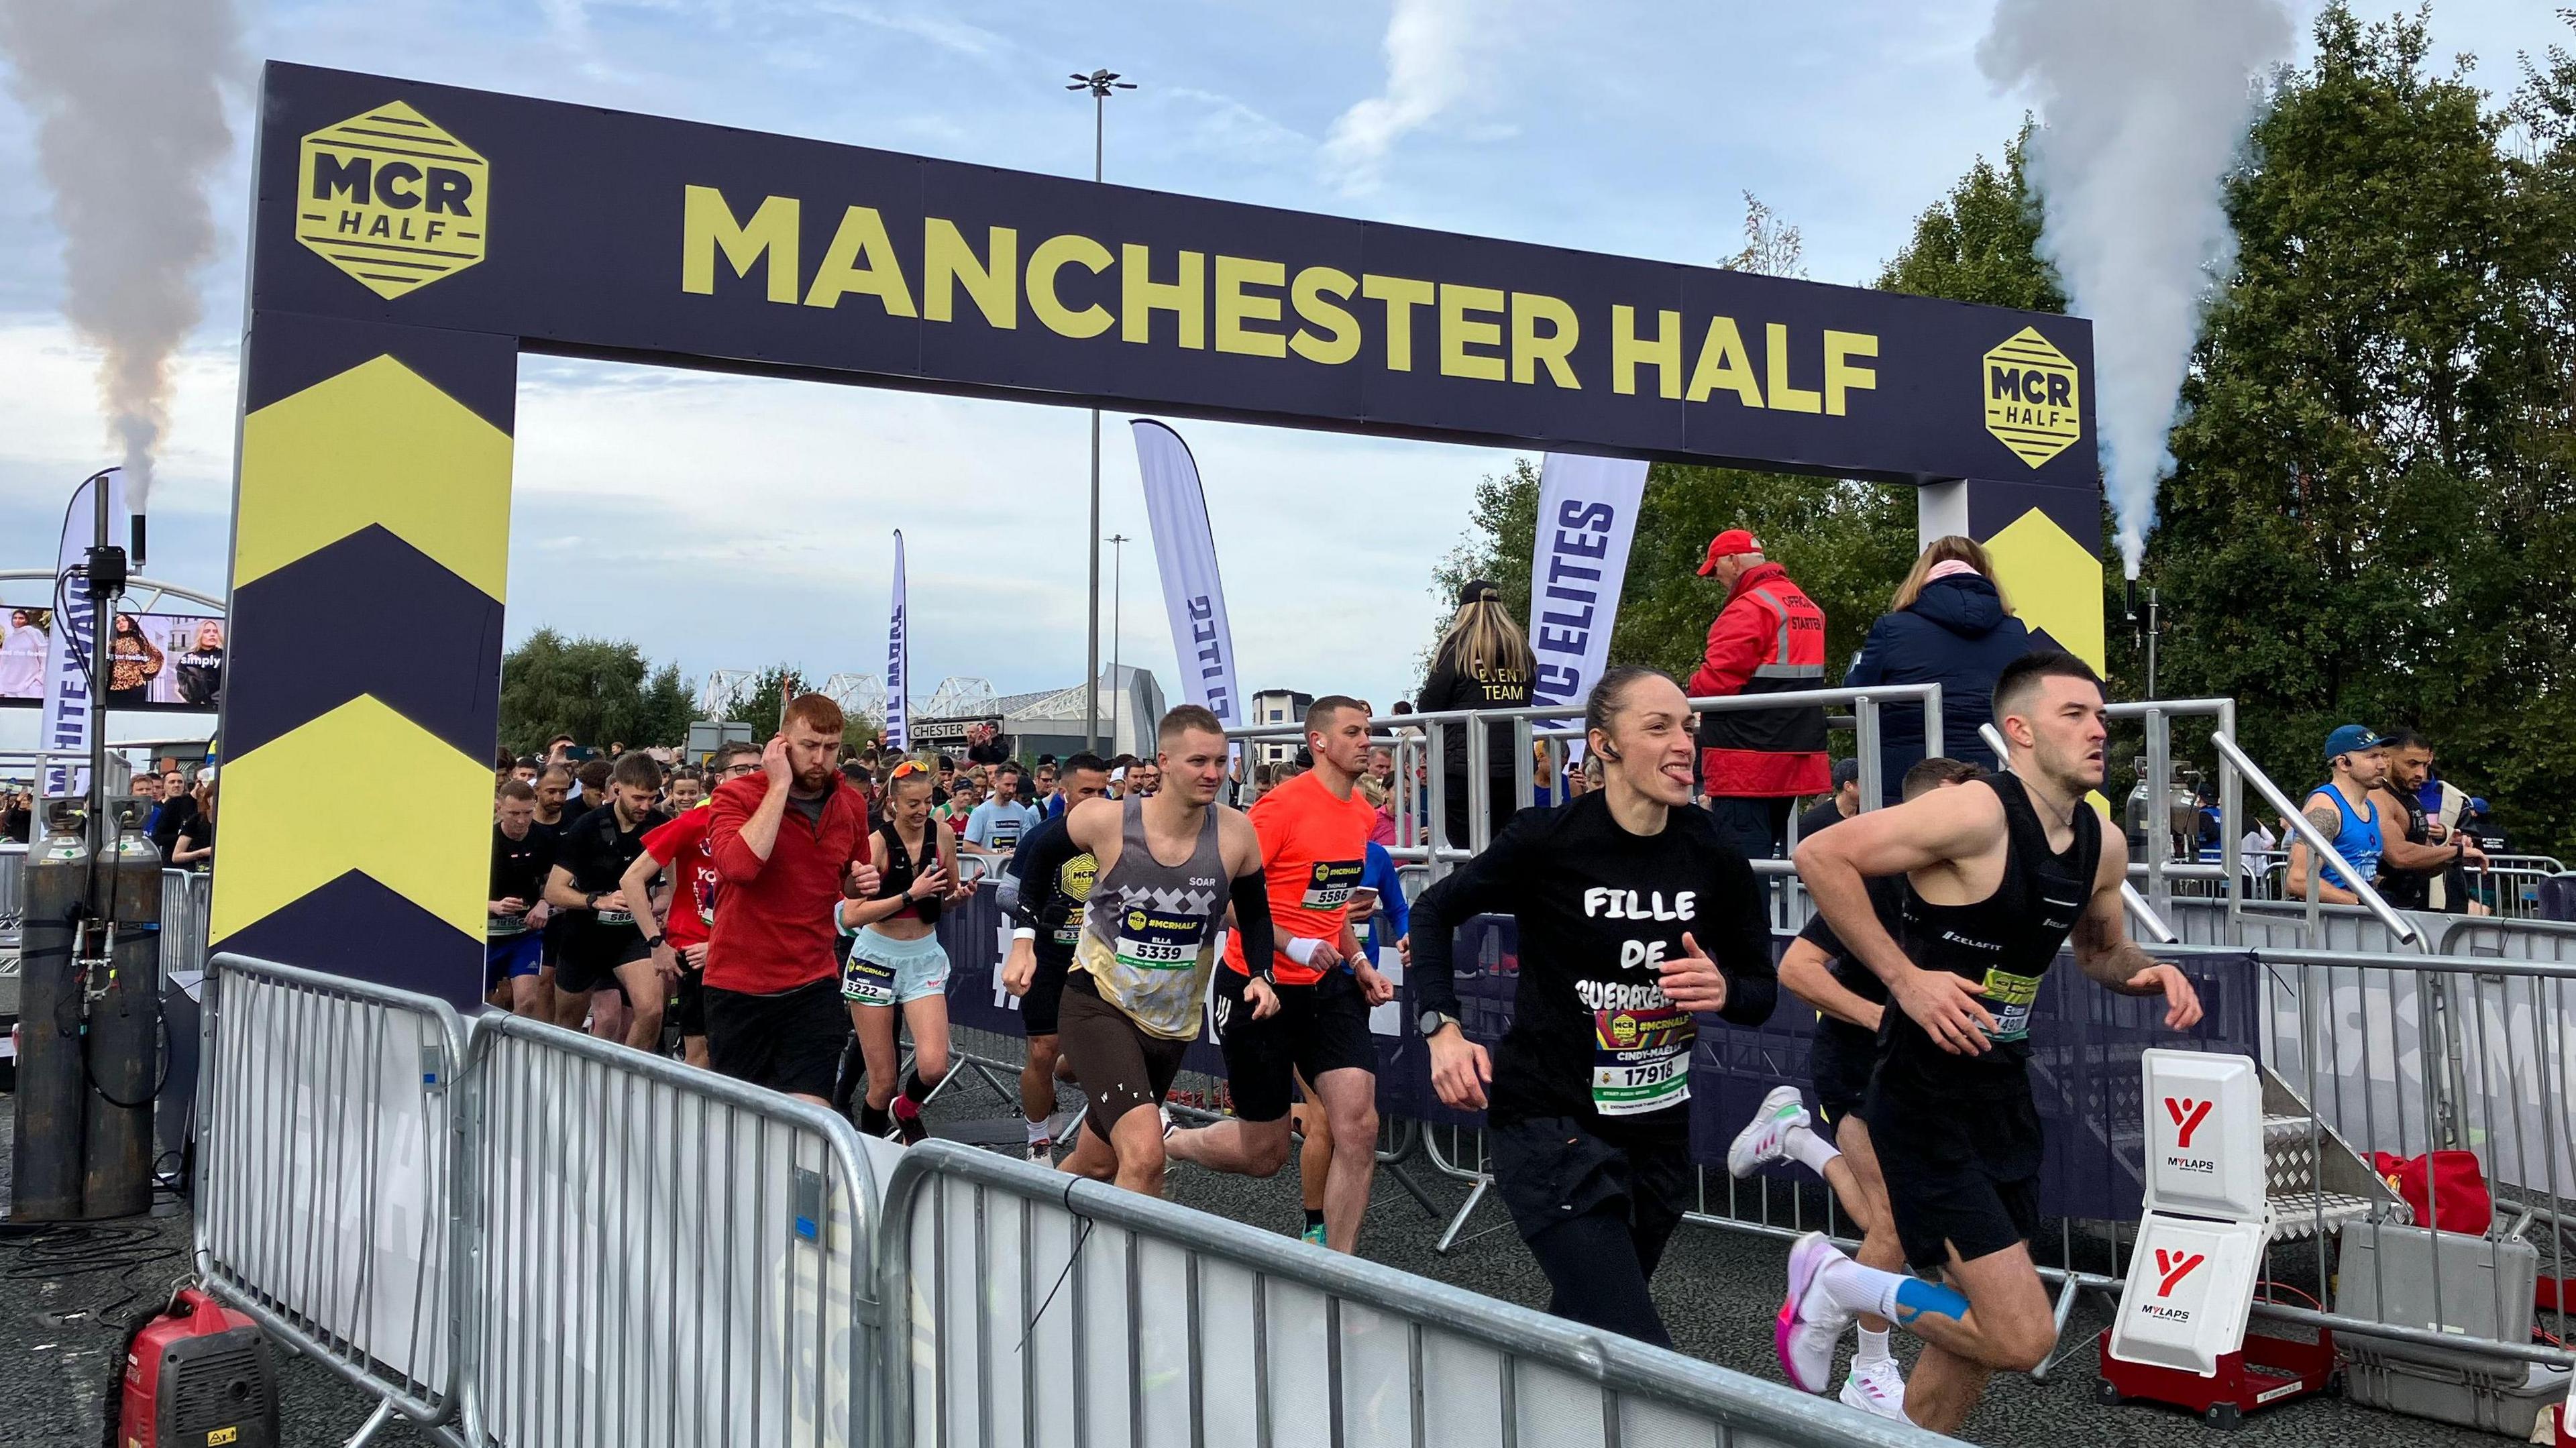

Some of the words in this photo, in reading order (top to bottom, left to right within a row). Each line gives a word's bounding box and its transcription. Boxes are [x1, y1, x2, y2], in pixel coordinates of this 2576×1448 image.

[313, 152, 473, 217] MCR
[338, 210, 447, 243] HALF
[682, 184, 1581, 390] MANCHESTER
[1612, 304, 1879, 416] HALF
[1990, 366, 2070, 409] MCR
[2006, 406, 2061, 429] HALF
[1538, 500, 1614, 656] ELITES
[180, 655, 221, 668] simply
[1482, 685, 1523, 700] TEAM
[913, 724, 964, 737] CHESTER
[698, 866, 717, 883] YO
[1189, 877, 1216, 887] SOAR
[1318, 890, 1348, 903] 5586
[1585, 887, 1696, 922] FILLE
[610, 913, 634, 922] 586
[1148, 919, 1197, 930] #MCRHALF
[1136, 944, 1181, 960] 5339
[1952, 935, 2003, 952] ZELAFIT
[1621, 940, 1667, 970] DE
[847, 982, 877, 997] 5222
[1640, 1015, 1689, 1032] #MCRHALF
[1625, 1060, 1673, 1087] 17918
[2167, 1156, 2214, 1170] MYLAPS
[2141, 1304, 2190, 1320] MYLAPS
